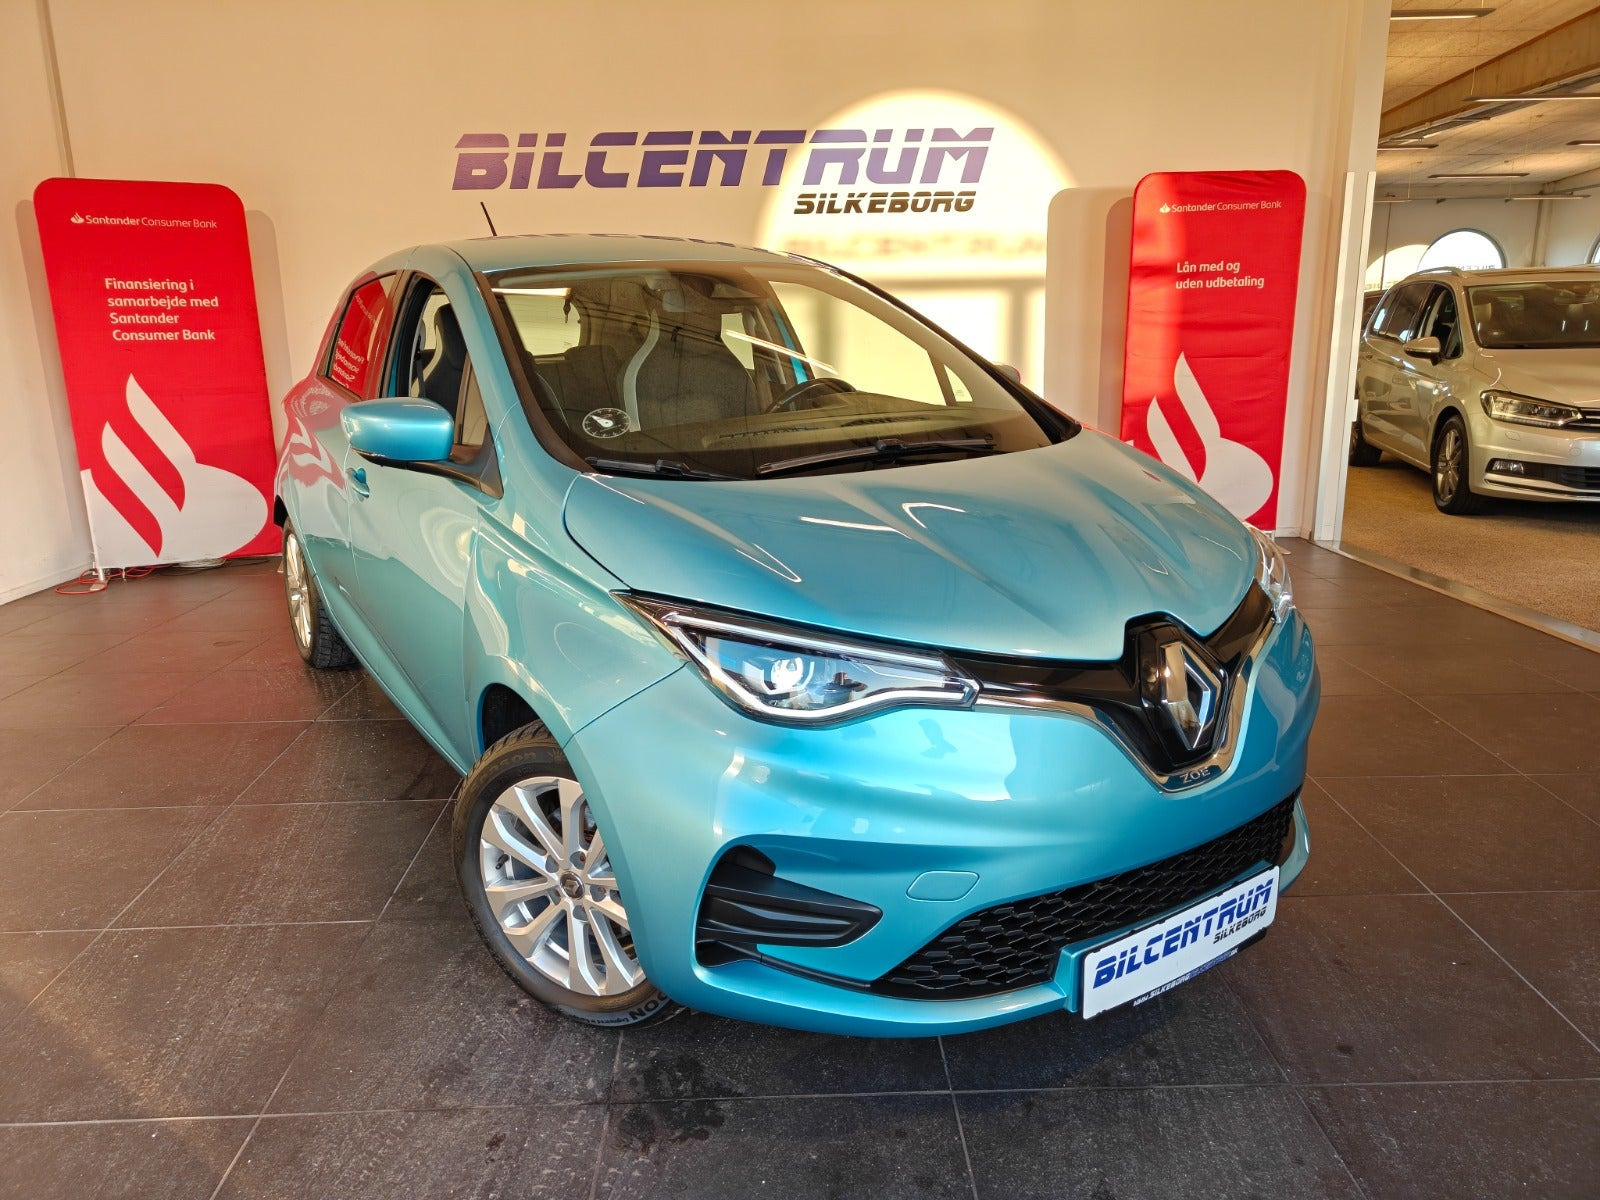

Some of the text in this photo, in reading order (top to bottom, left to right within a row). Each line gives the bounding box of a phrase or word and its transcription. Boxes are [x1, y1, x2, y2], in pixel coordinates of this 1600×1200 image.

[452, 127, 994, 191] BILCENTRUM
[793, 190, 976, 215] SILKEBORG
[1171, 200, 1282, 213] Santander Consumer Bank
[85, 214, 217, 229] Santander Consumer Bank
[1176, 260, 1241, 274] Lån med og
[104, 277, 195, 293] Finansiering i
[1175, 276, 1265, 289] uden udbetaling
[107, 295, 219, 310] samarbejde med
[110, 312, 180, 324] Santander
[112, 329, 216, 341] Consumer Bank
[1179, 766, 1211, 784] ZOE
[1213, 906, 1268, 945] SILKEBORG
[1092, 878, 1274, 989] BILCENTRUM
